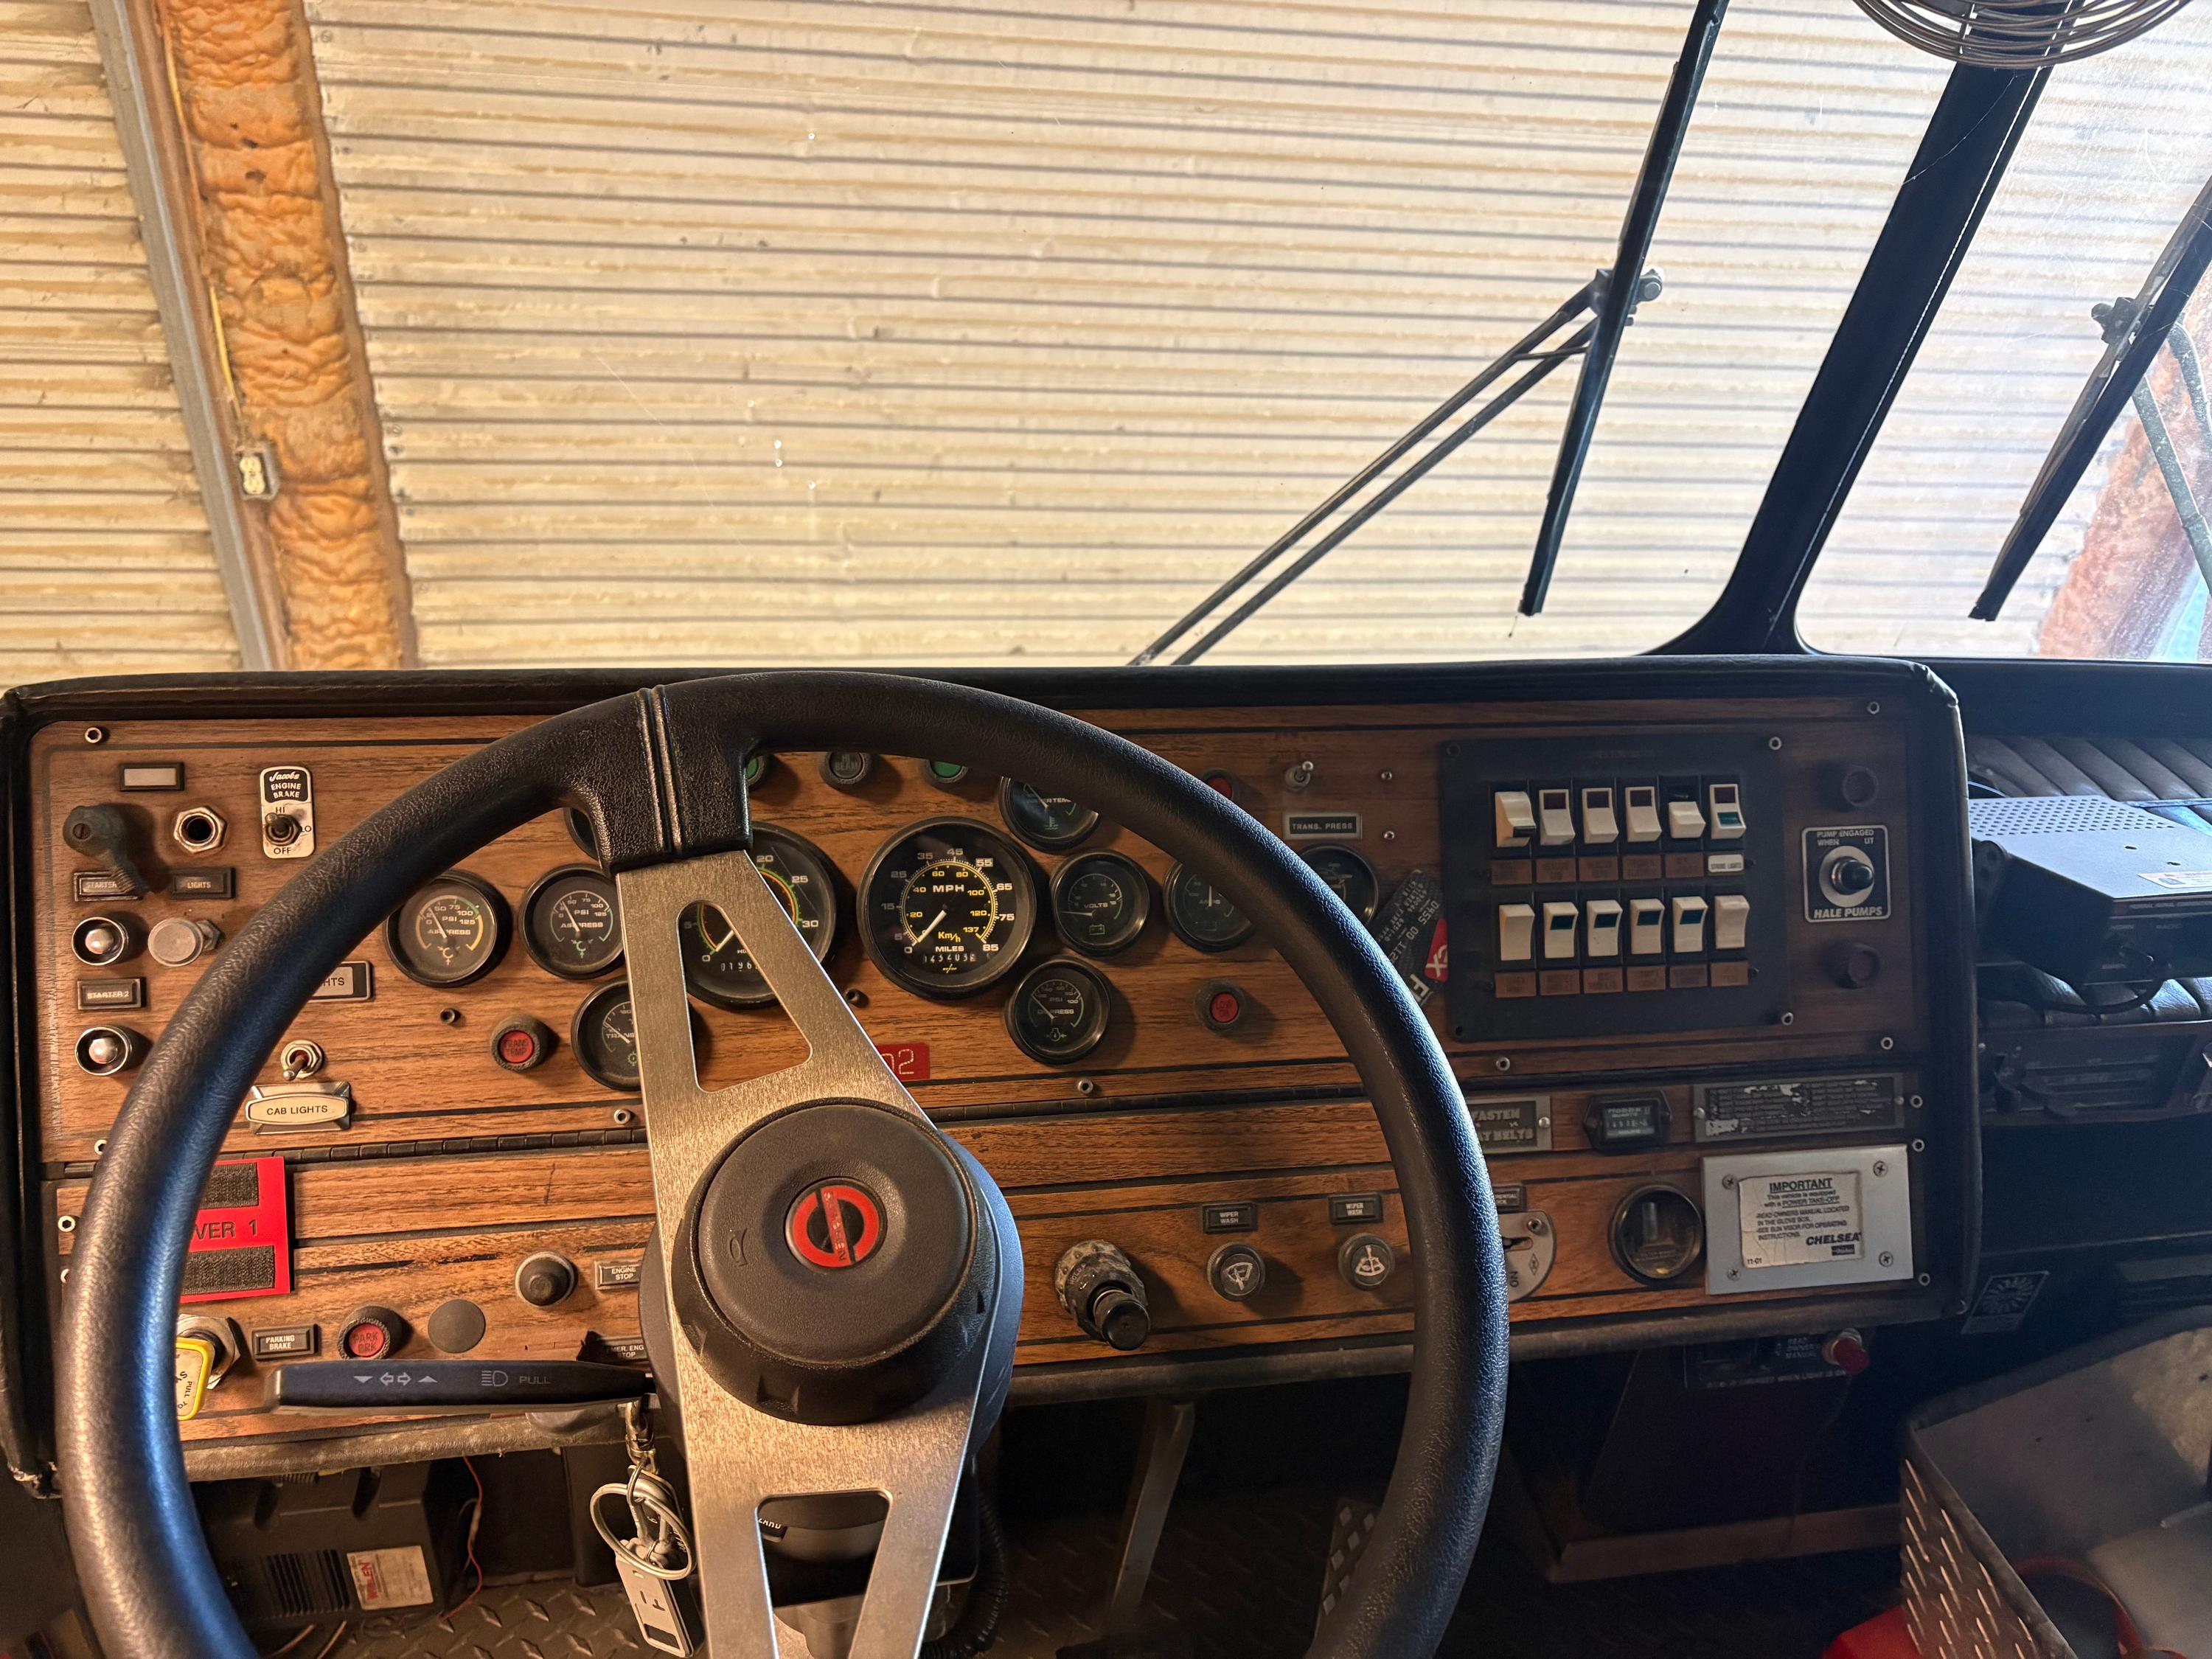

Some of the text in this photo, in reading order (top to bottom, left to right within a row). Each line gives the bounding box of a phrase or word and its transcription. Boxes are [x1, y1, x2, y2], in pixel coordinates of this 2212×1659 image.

[269, 771, 300, 782] Jacobs
[271, 782, 302, 790] ENGINE
[273, 790, 300, 799] BRAKE
[1839, 830, 1874, 838] ENGAGED
[975, 858, 993, 866] 55
[791, 875, 809, 883] 25
[187, 881, 212, 889] LIGHTS
[933, 885, 964, 893] MPH
[1814, 906, 1882, 919] HALE PUMPS
[938, 931, 961, 942] Km/h
[266, 1105, 328, 1116] CAB LIGHTS
[1770, 1178, 1832, 1192] IMPORTANT
[1782, 1199, 1806, 1207] POWER
[248, 1219, 257, 1236] 1
[1815, 1220, 1847, 1229] OPERATING
[1806, 1234, 1860, 1245] CHELSEA
[265, 1335, 295, 1343] PARKING
[352, 1332, 378, 1343] PARK
[269, 1342, 291, 1350] BRAKE
[519, 1376, 551, 1385] PULL
[178, 1381, 193, 1409] PULL TO
